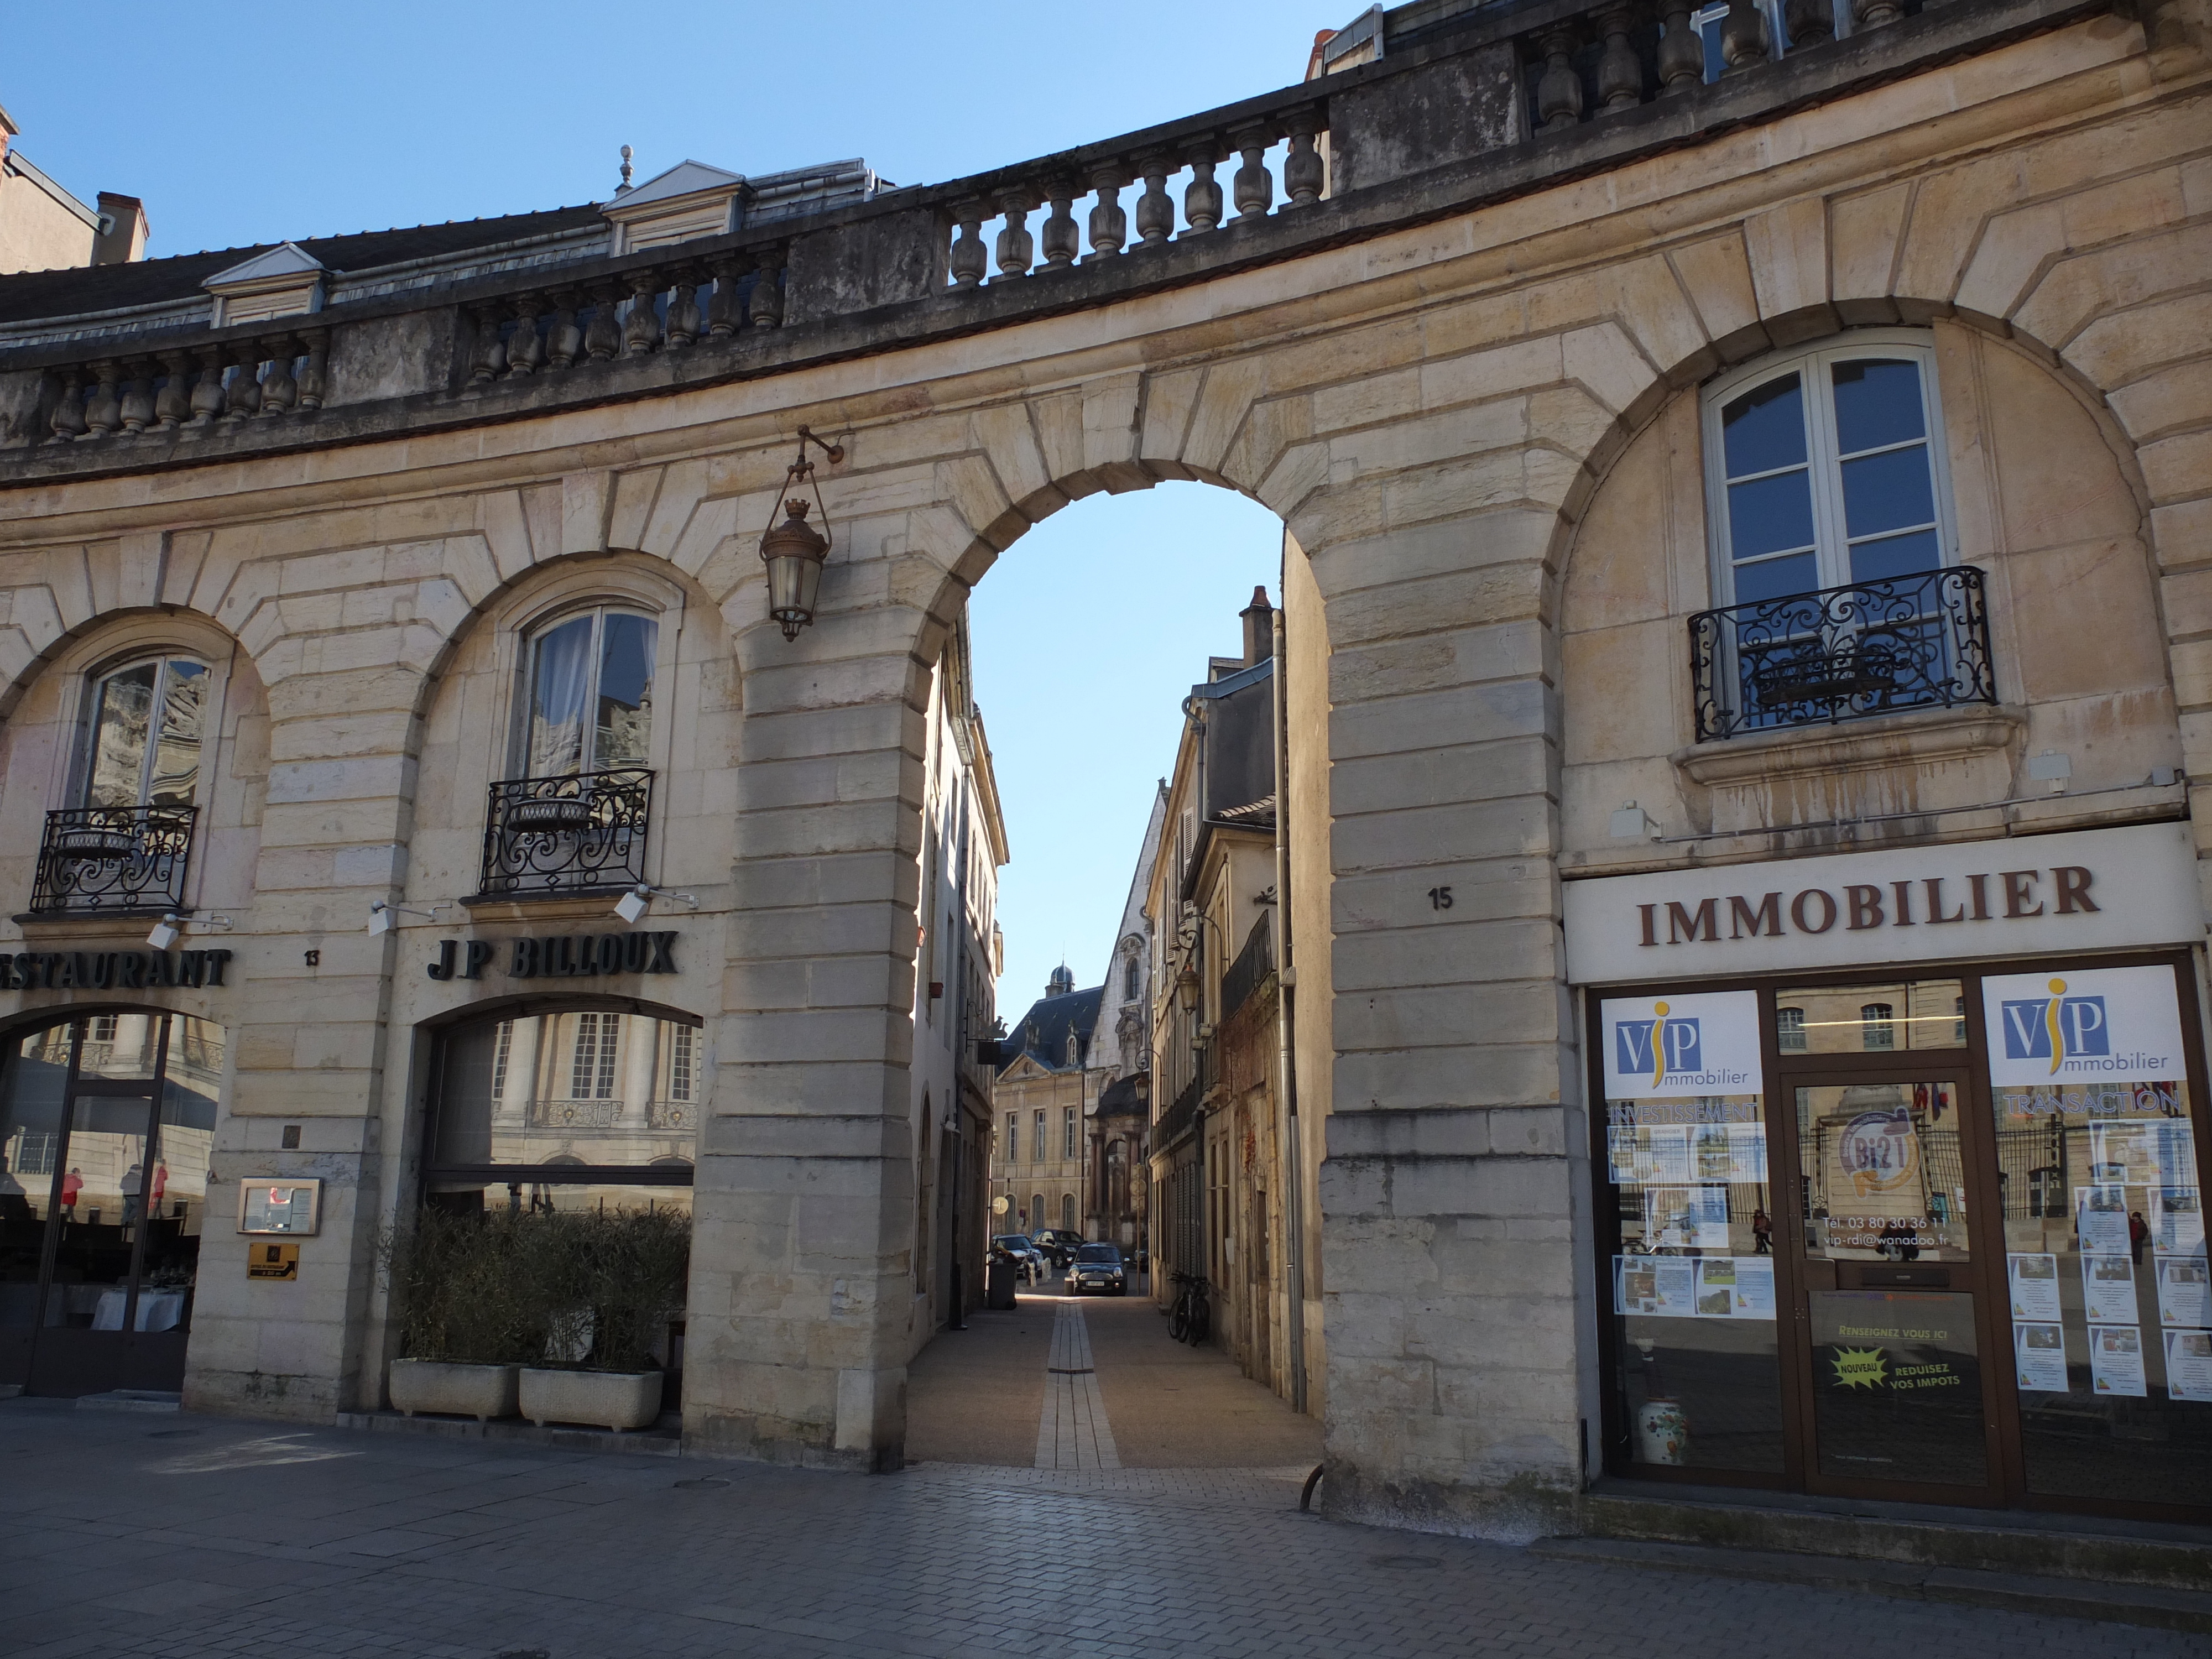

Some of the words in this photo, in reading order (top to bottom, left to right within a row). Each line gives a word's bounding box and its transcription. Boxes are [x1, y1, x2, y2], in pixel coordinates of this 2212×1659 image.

[1428, 886, 1453, 910] 15
[1636, 865, 2101, 947] IMMOBILIER
[304, 950, 320, 966] 13
[427, 940, 457, 981] J
[457, 940, 494, 980] P
[508, 930, 680, 978] BILLOUX
[2003, 1089, 2181, 1115] TRANSACTION
[1609, 1102, 1758, 1125] INVESTISSEMENT
[1854, 1135, 1905, 1169] Bi21
[1824, 1217, 1844, 1229] Tél.
[1848, 1217, 1865, 1229] 03
[1869, 1217, 1885, 1229] 80
[1890, 1217, 1906, 1229] 30
[1910, 1217, 1927, 1229] 36
[1933, 1217, 1947, 1229] 11
[1824, 1233, 1949, 1247] vip-rdi@wanadoo.fr
[1838, 1326, 1900, 1338] RENSEIGNEZ
[1903, 1329, 1931, 1339] VOUS
[1934, 1331, 1948, 1339] ICI
[1841, 1363, 1878, 1374] NOUVEAU
[1895, 1363, 1950, 1377] REDUISEZ
[1890, 1380, 1914, 1390] VOS
[1917, 1375, 1961, 1389] IMPOTS
